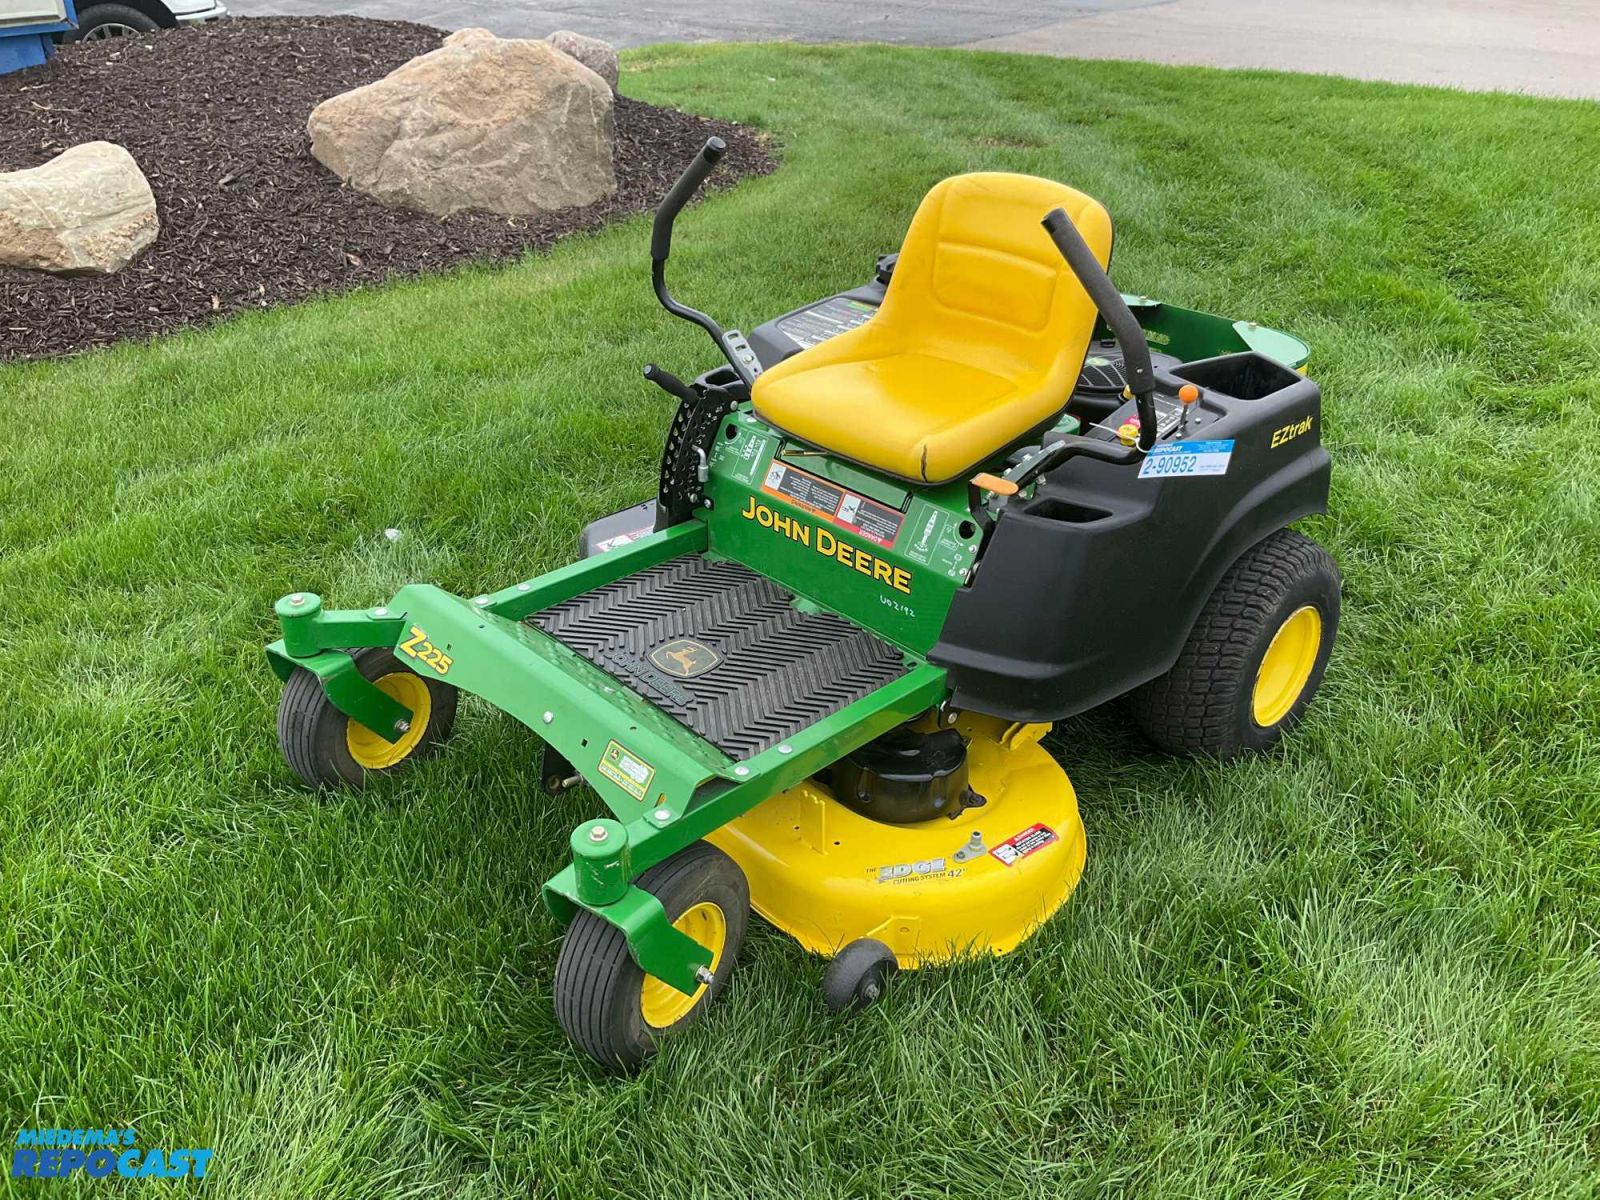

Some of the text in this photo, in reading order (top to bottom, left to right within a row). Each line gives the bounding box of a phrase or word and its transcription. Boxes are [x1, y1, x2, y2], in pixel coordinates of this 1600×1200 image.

[1270, 415, 1314, 449] EZtrak
[1142, 455, 1197, 475] 2-90952
[742, 496, 810, 548] JOHN
[816, 526, 912, 595] DEERE
[399, 625, 454, 676] Z225
[920, 872, 946, 881] SYSTEM
